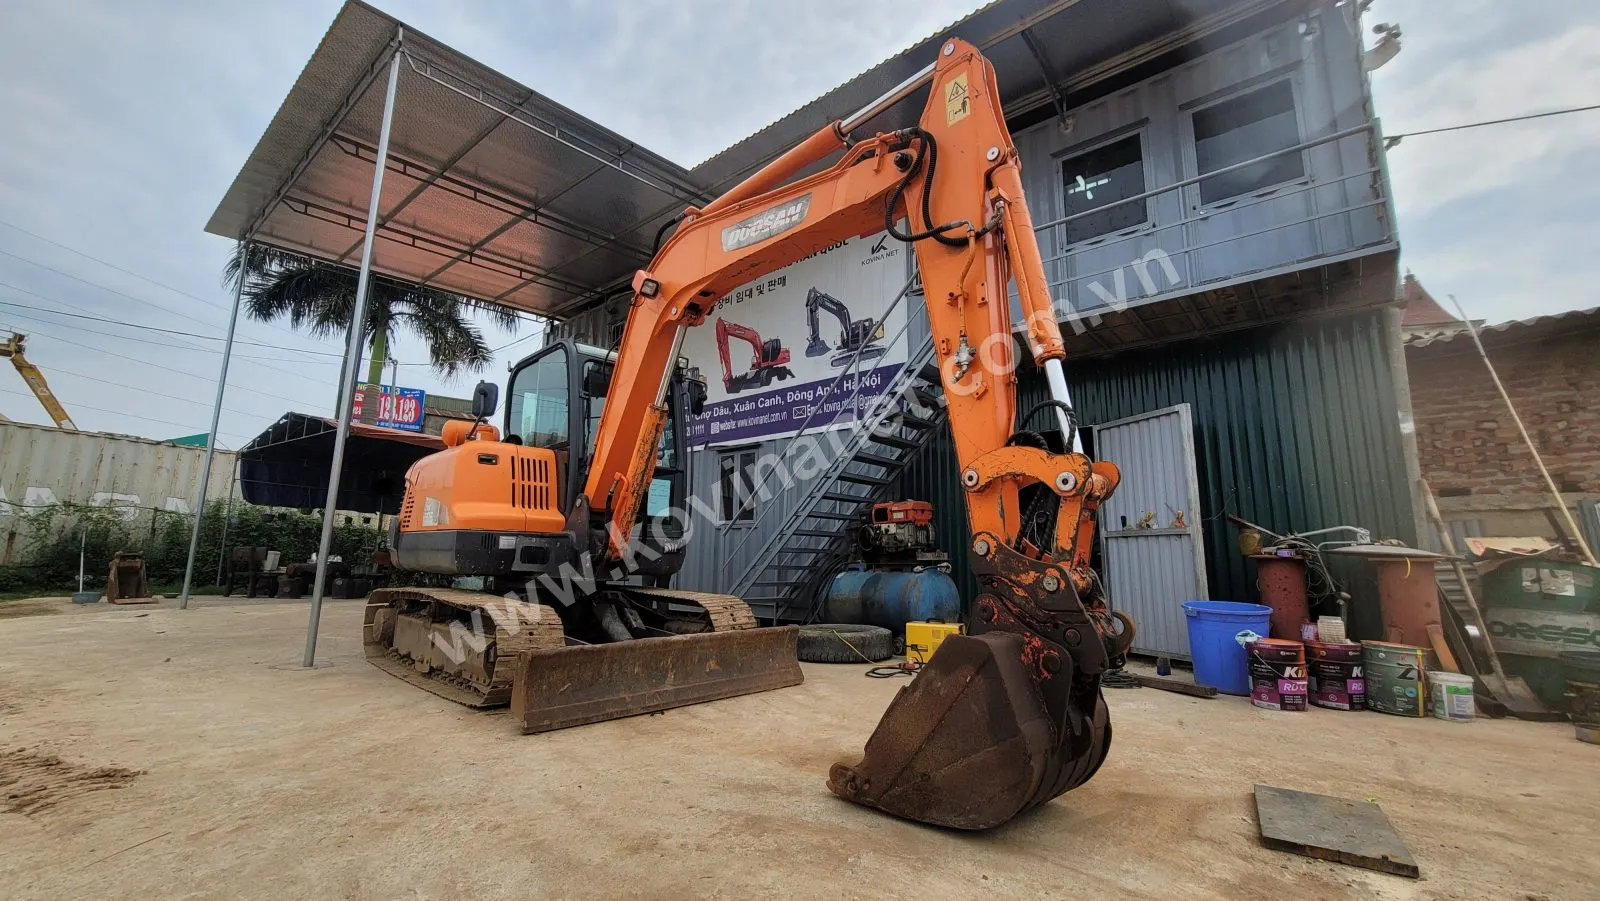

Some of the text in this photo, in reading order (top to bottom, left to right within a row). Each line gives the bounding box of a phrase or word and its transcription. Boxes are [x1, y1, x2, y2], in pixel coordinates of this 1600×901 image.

[861, 249, 900, 267] KOVINA NET
[735, 288, 753, 303] 임대
[756, 283, 765, 296] 및
[767, 275, 787, 292] 판매
[733, 400, 756, 413] Xuân
[757, 395, 785, 408] Canh,
[787, 390, 814, 402] Đông
[862, 373, 881, 388] Nội
